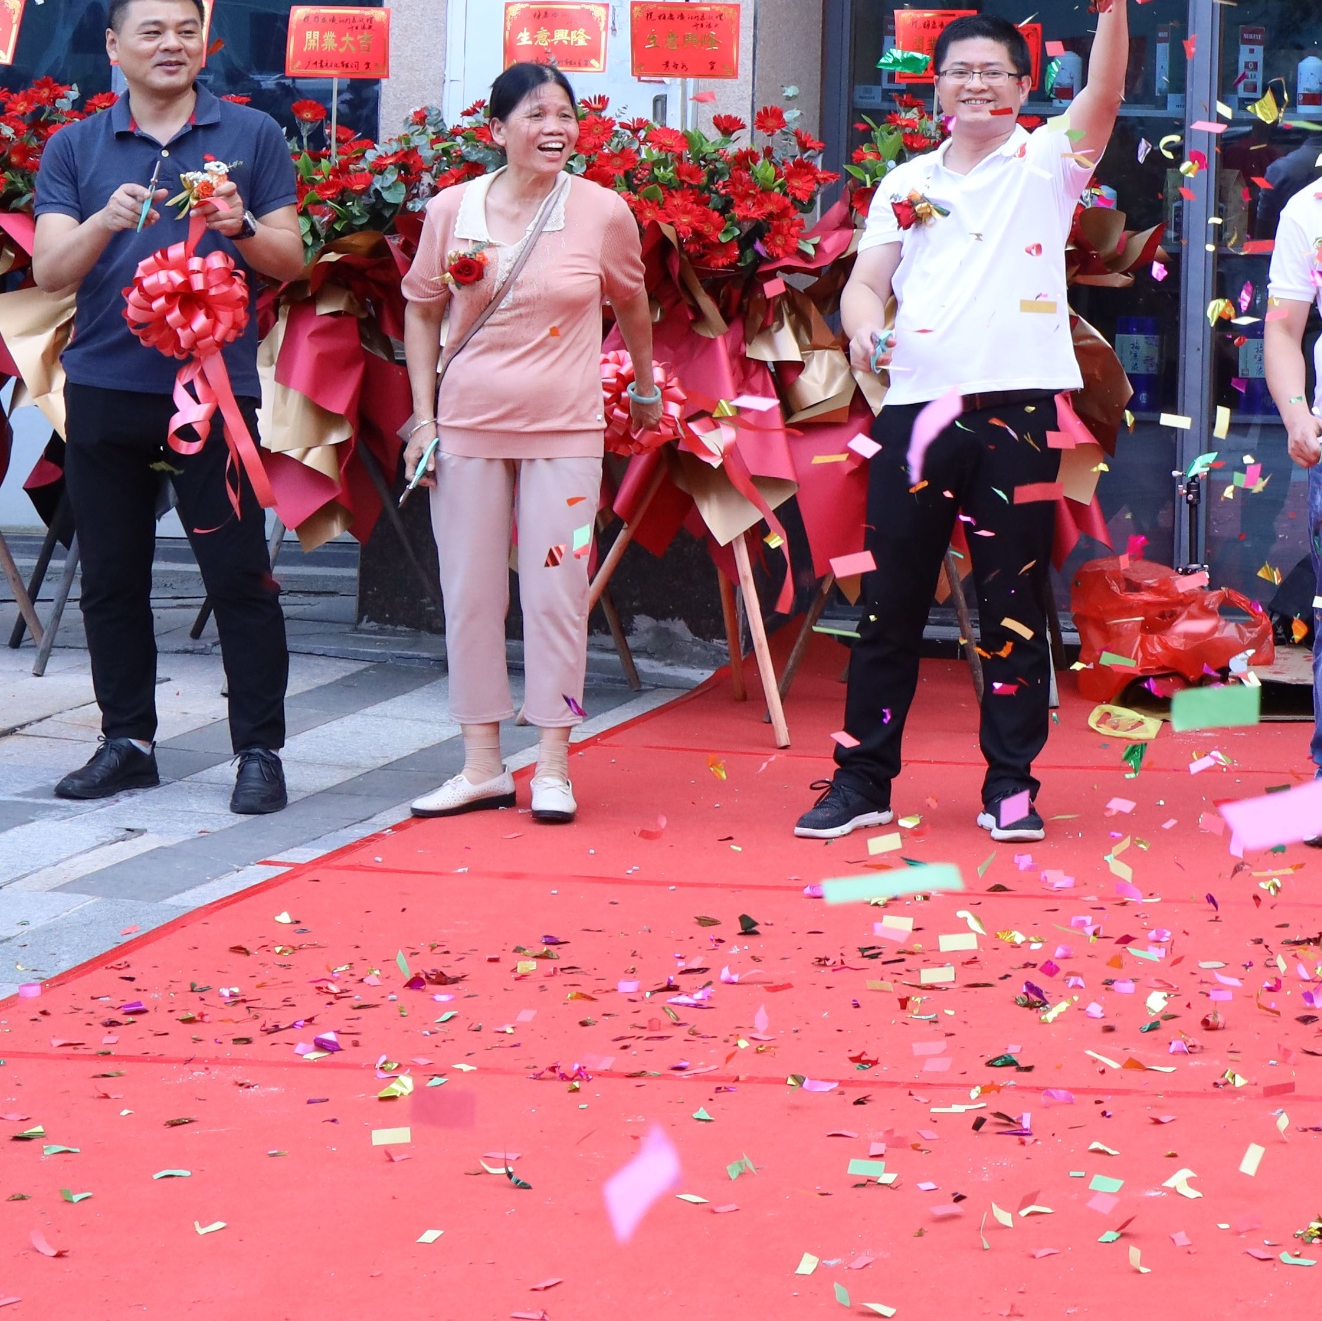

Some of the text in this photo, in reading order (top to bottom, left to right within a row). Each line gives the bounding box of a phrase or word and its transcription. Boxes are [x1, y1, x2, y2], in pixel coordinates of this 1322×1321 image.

[303, 30, 374, 53] 開業大吉
[516, 27, 591, 47] 生意興隆
[644, 29, 722, 50] 生意興隆
